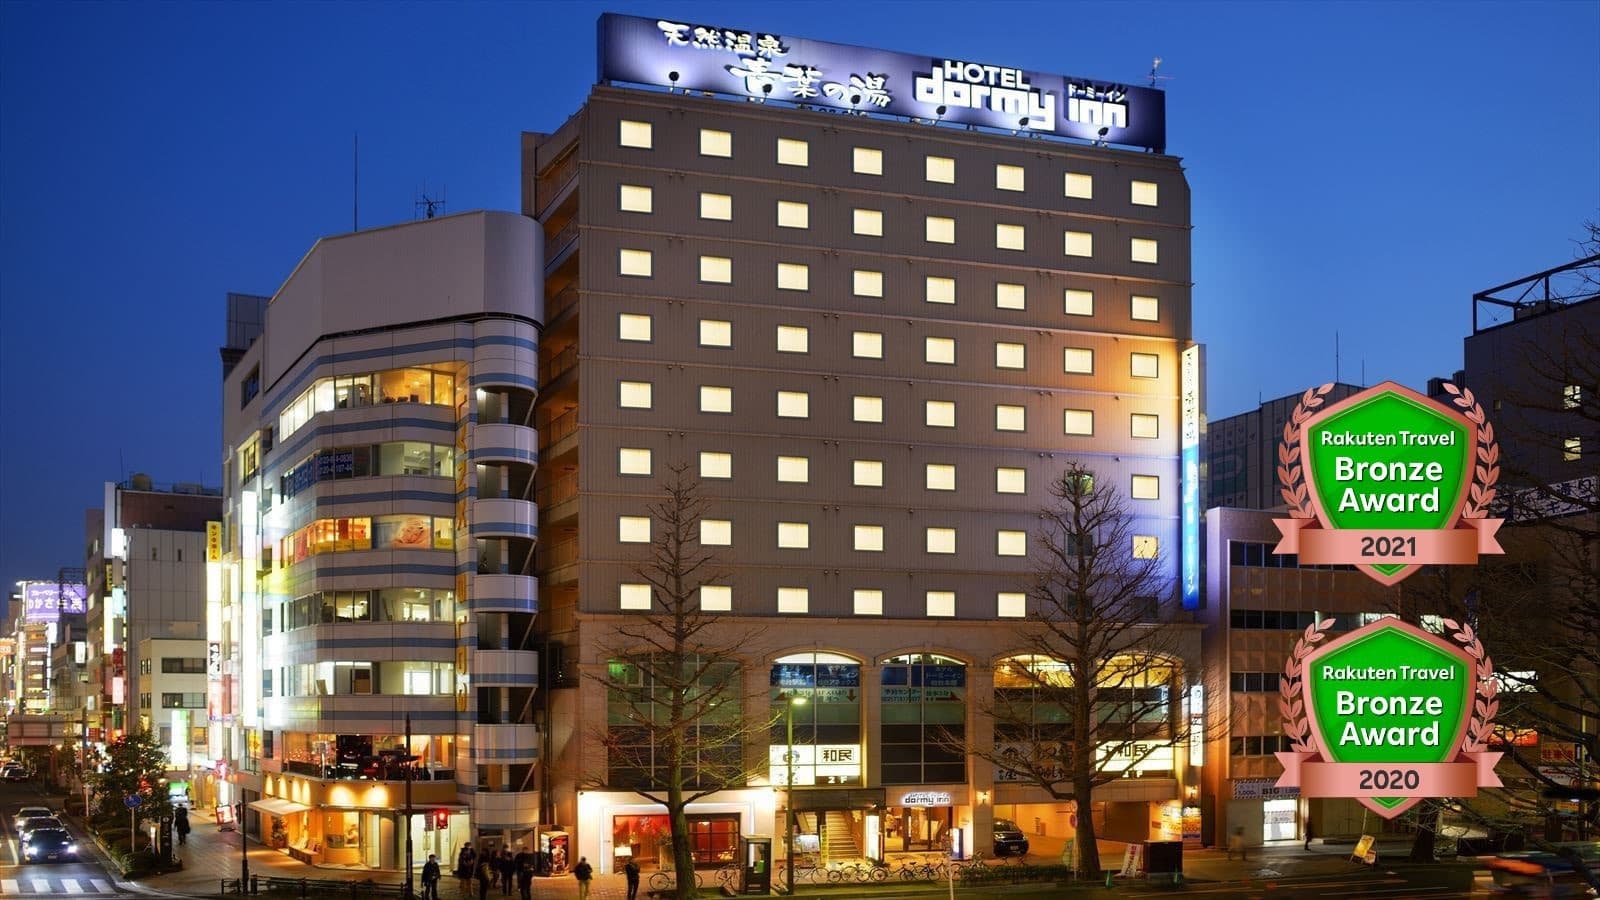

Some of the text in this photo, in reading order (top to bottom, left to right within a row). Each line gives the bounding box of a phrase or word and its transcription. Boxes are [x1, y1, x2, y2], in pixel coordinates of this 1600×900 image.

[657, 20, 789, 58] 天然温泉
[725, 57, 892, 108] 青葉の湯
[944, 59, 1030, 90] HOTEL
[915, 66, 1127, 131] dormy inn
[1068, 83, 1125, 102] ドーミーイン
[823, 749, 853, 762] 和民
[905, 796, 934, 806] dormy
